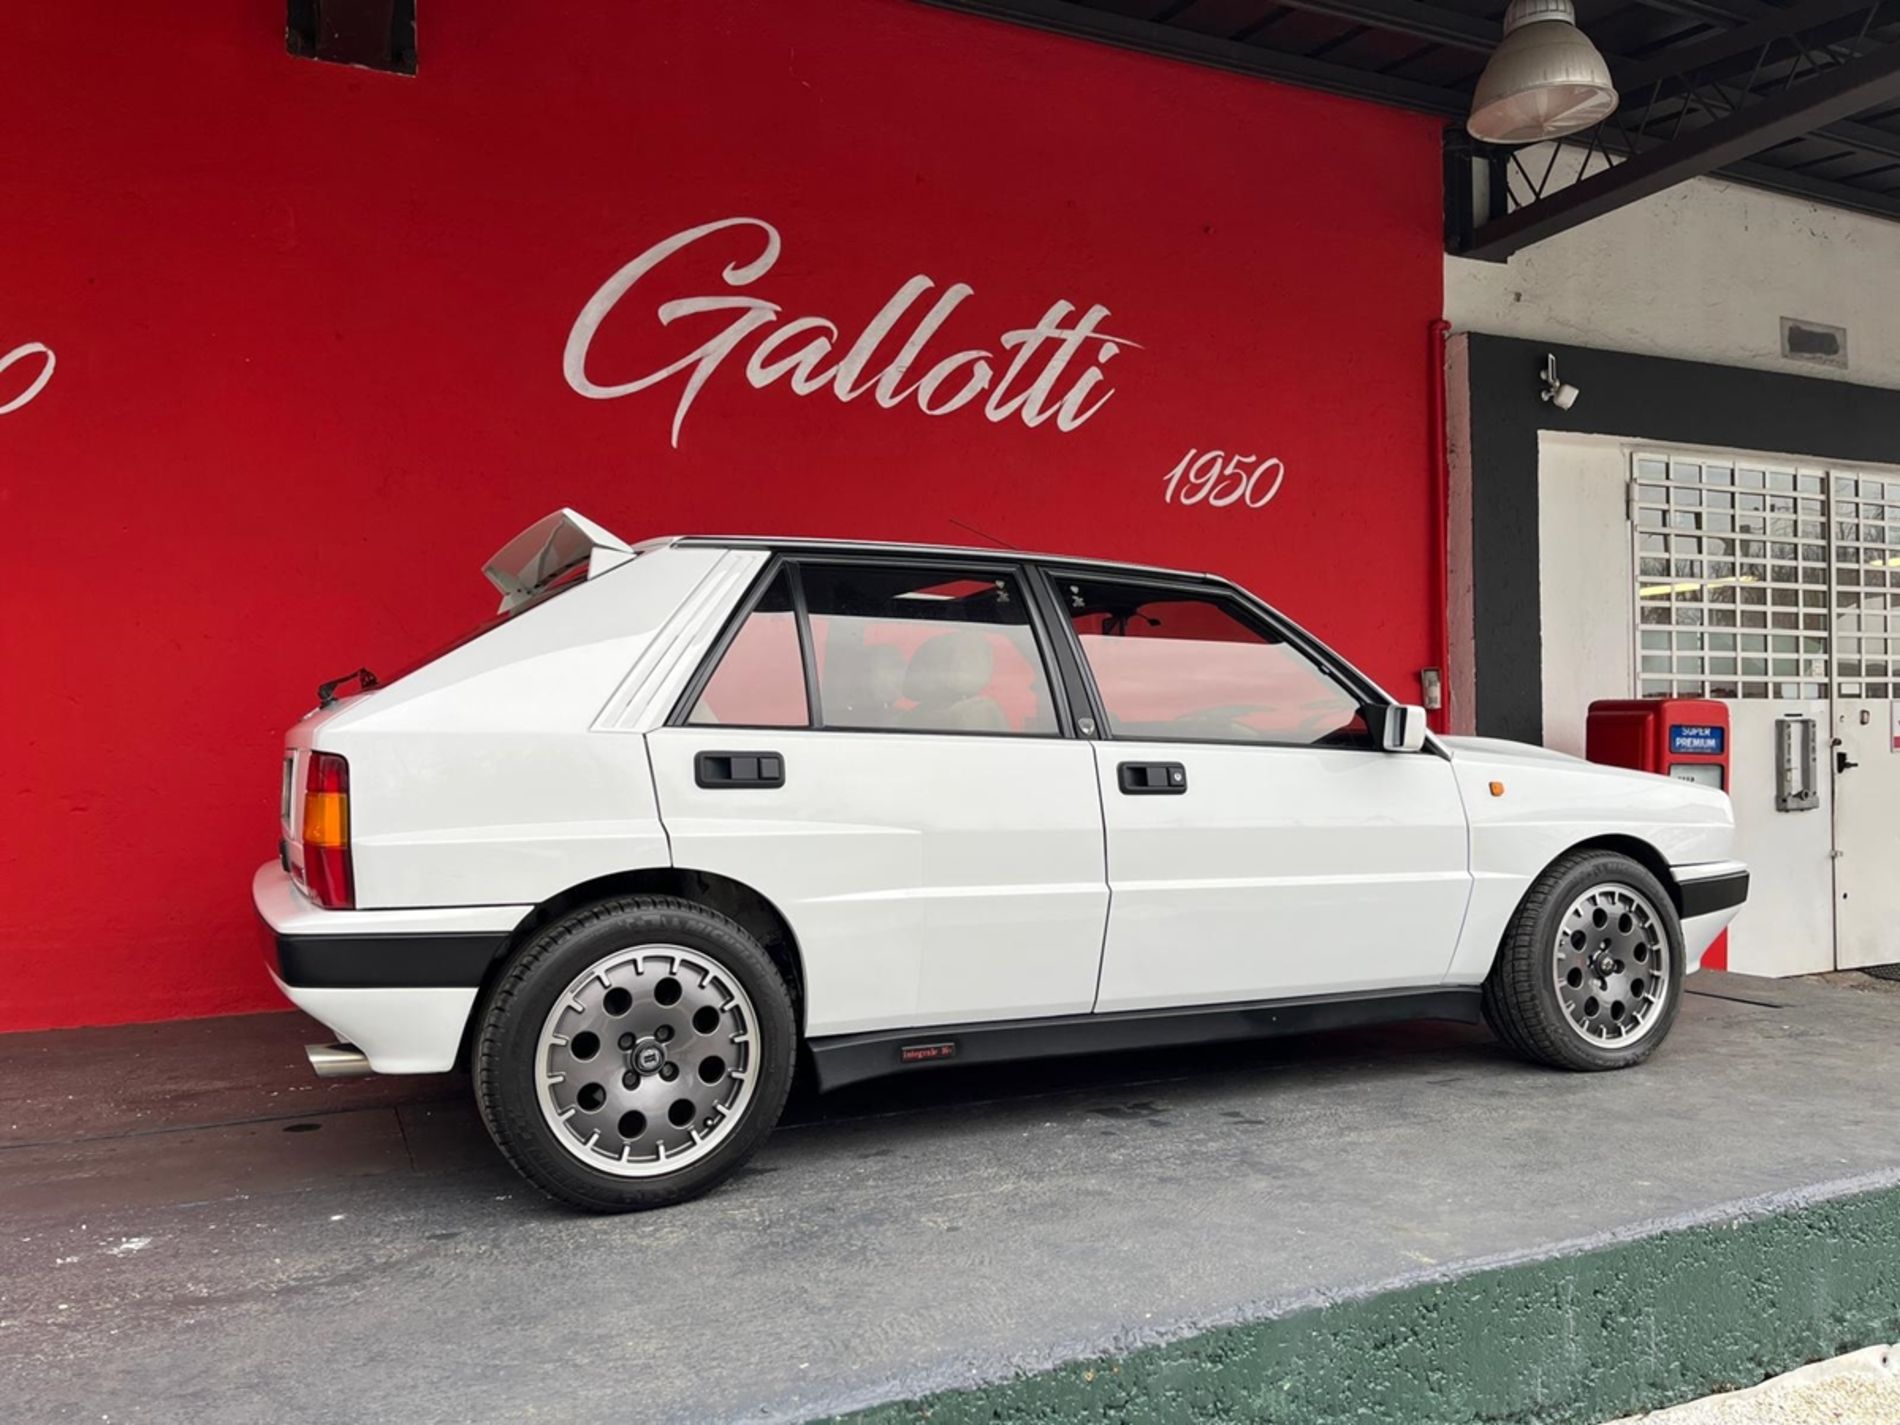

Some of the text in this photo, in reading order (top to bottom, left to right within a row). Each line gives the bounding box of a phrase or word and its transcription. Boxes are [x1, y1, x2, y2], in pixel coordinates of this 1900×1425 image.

[563, 217, 1143, 449] Gallotti
[1163, 448, 1285, 508] 1950
[1675, 737, 1716, 748] PREMIUM
